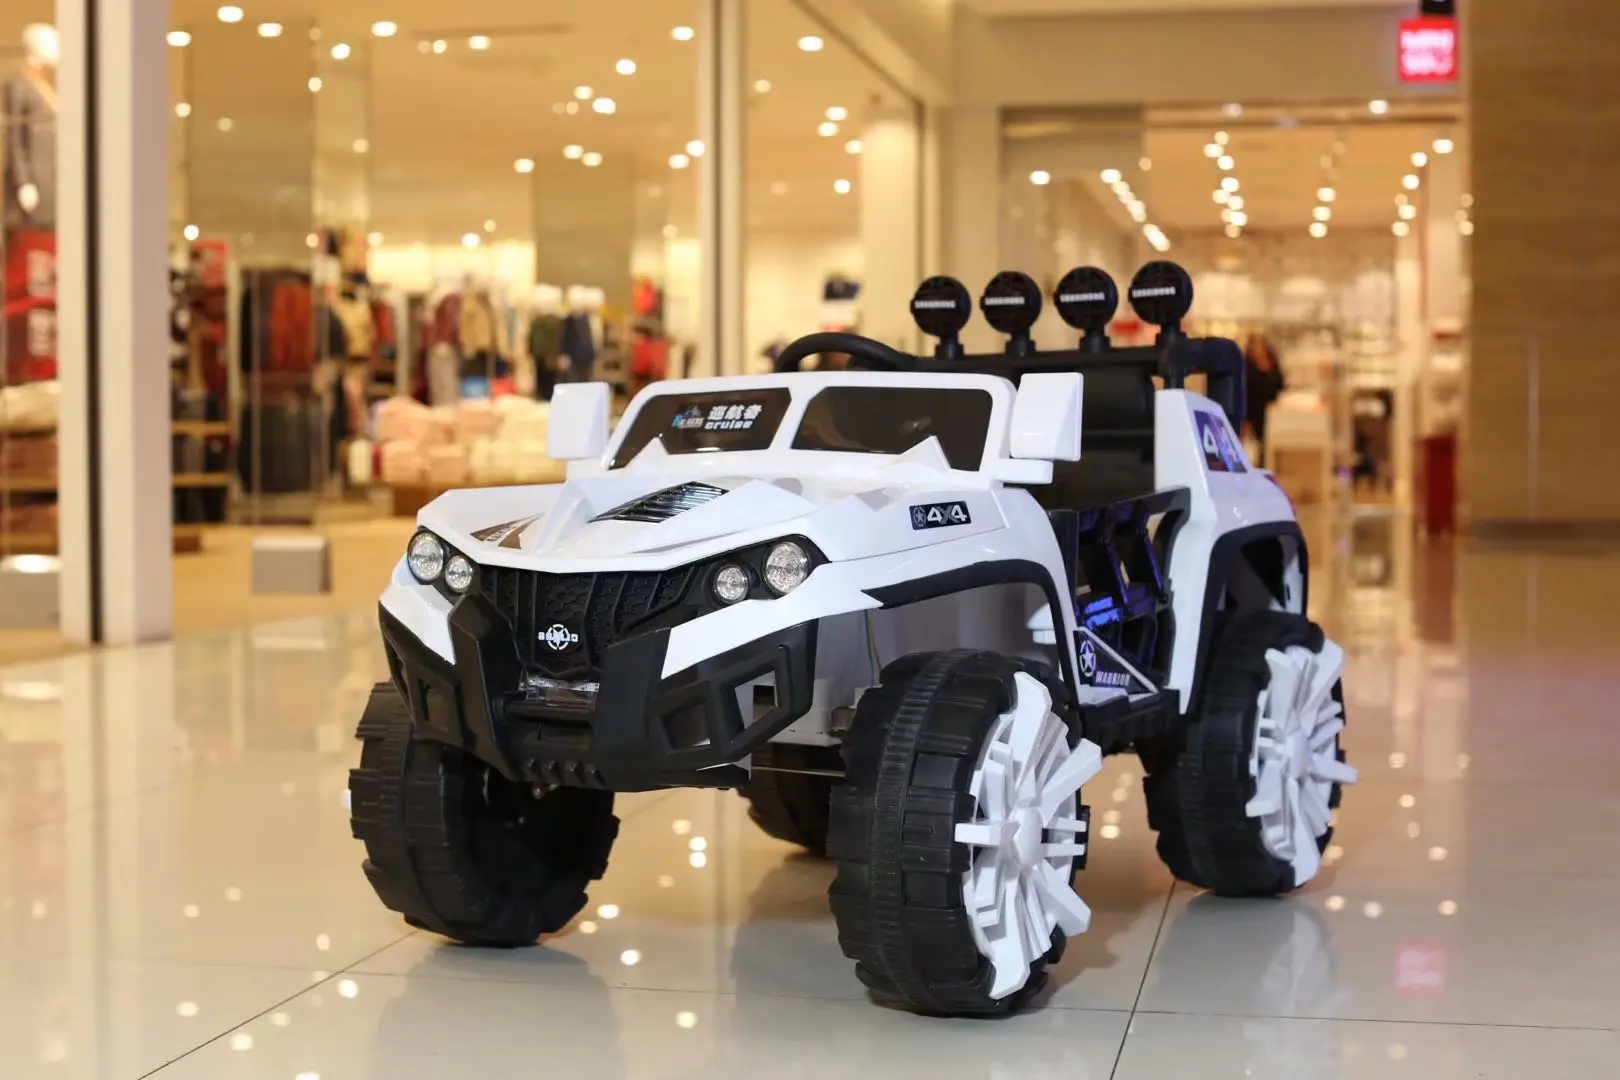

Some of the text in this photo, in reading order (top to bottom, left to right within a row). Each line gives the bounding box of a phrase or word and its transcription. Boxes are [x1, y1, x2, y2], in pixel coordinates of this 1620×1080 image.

[704, 419, 753, 430] cruise
[927, 504, 967, 525] 4X4
[1095, 671, 1130, 686] WARRIOR
